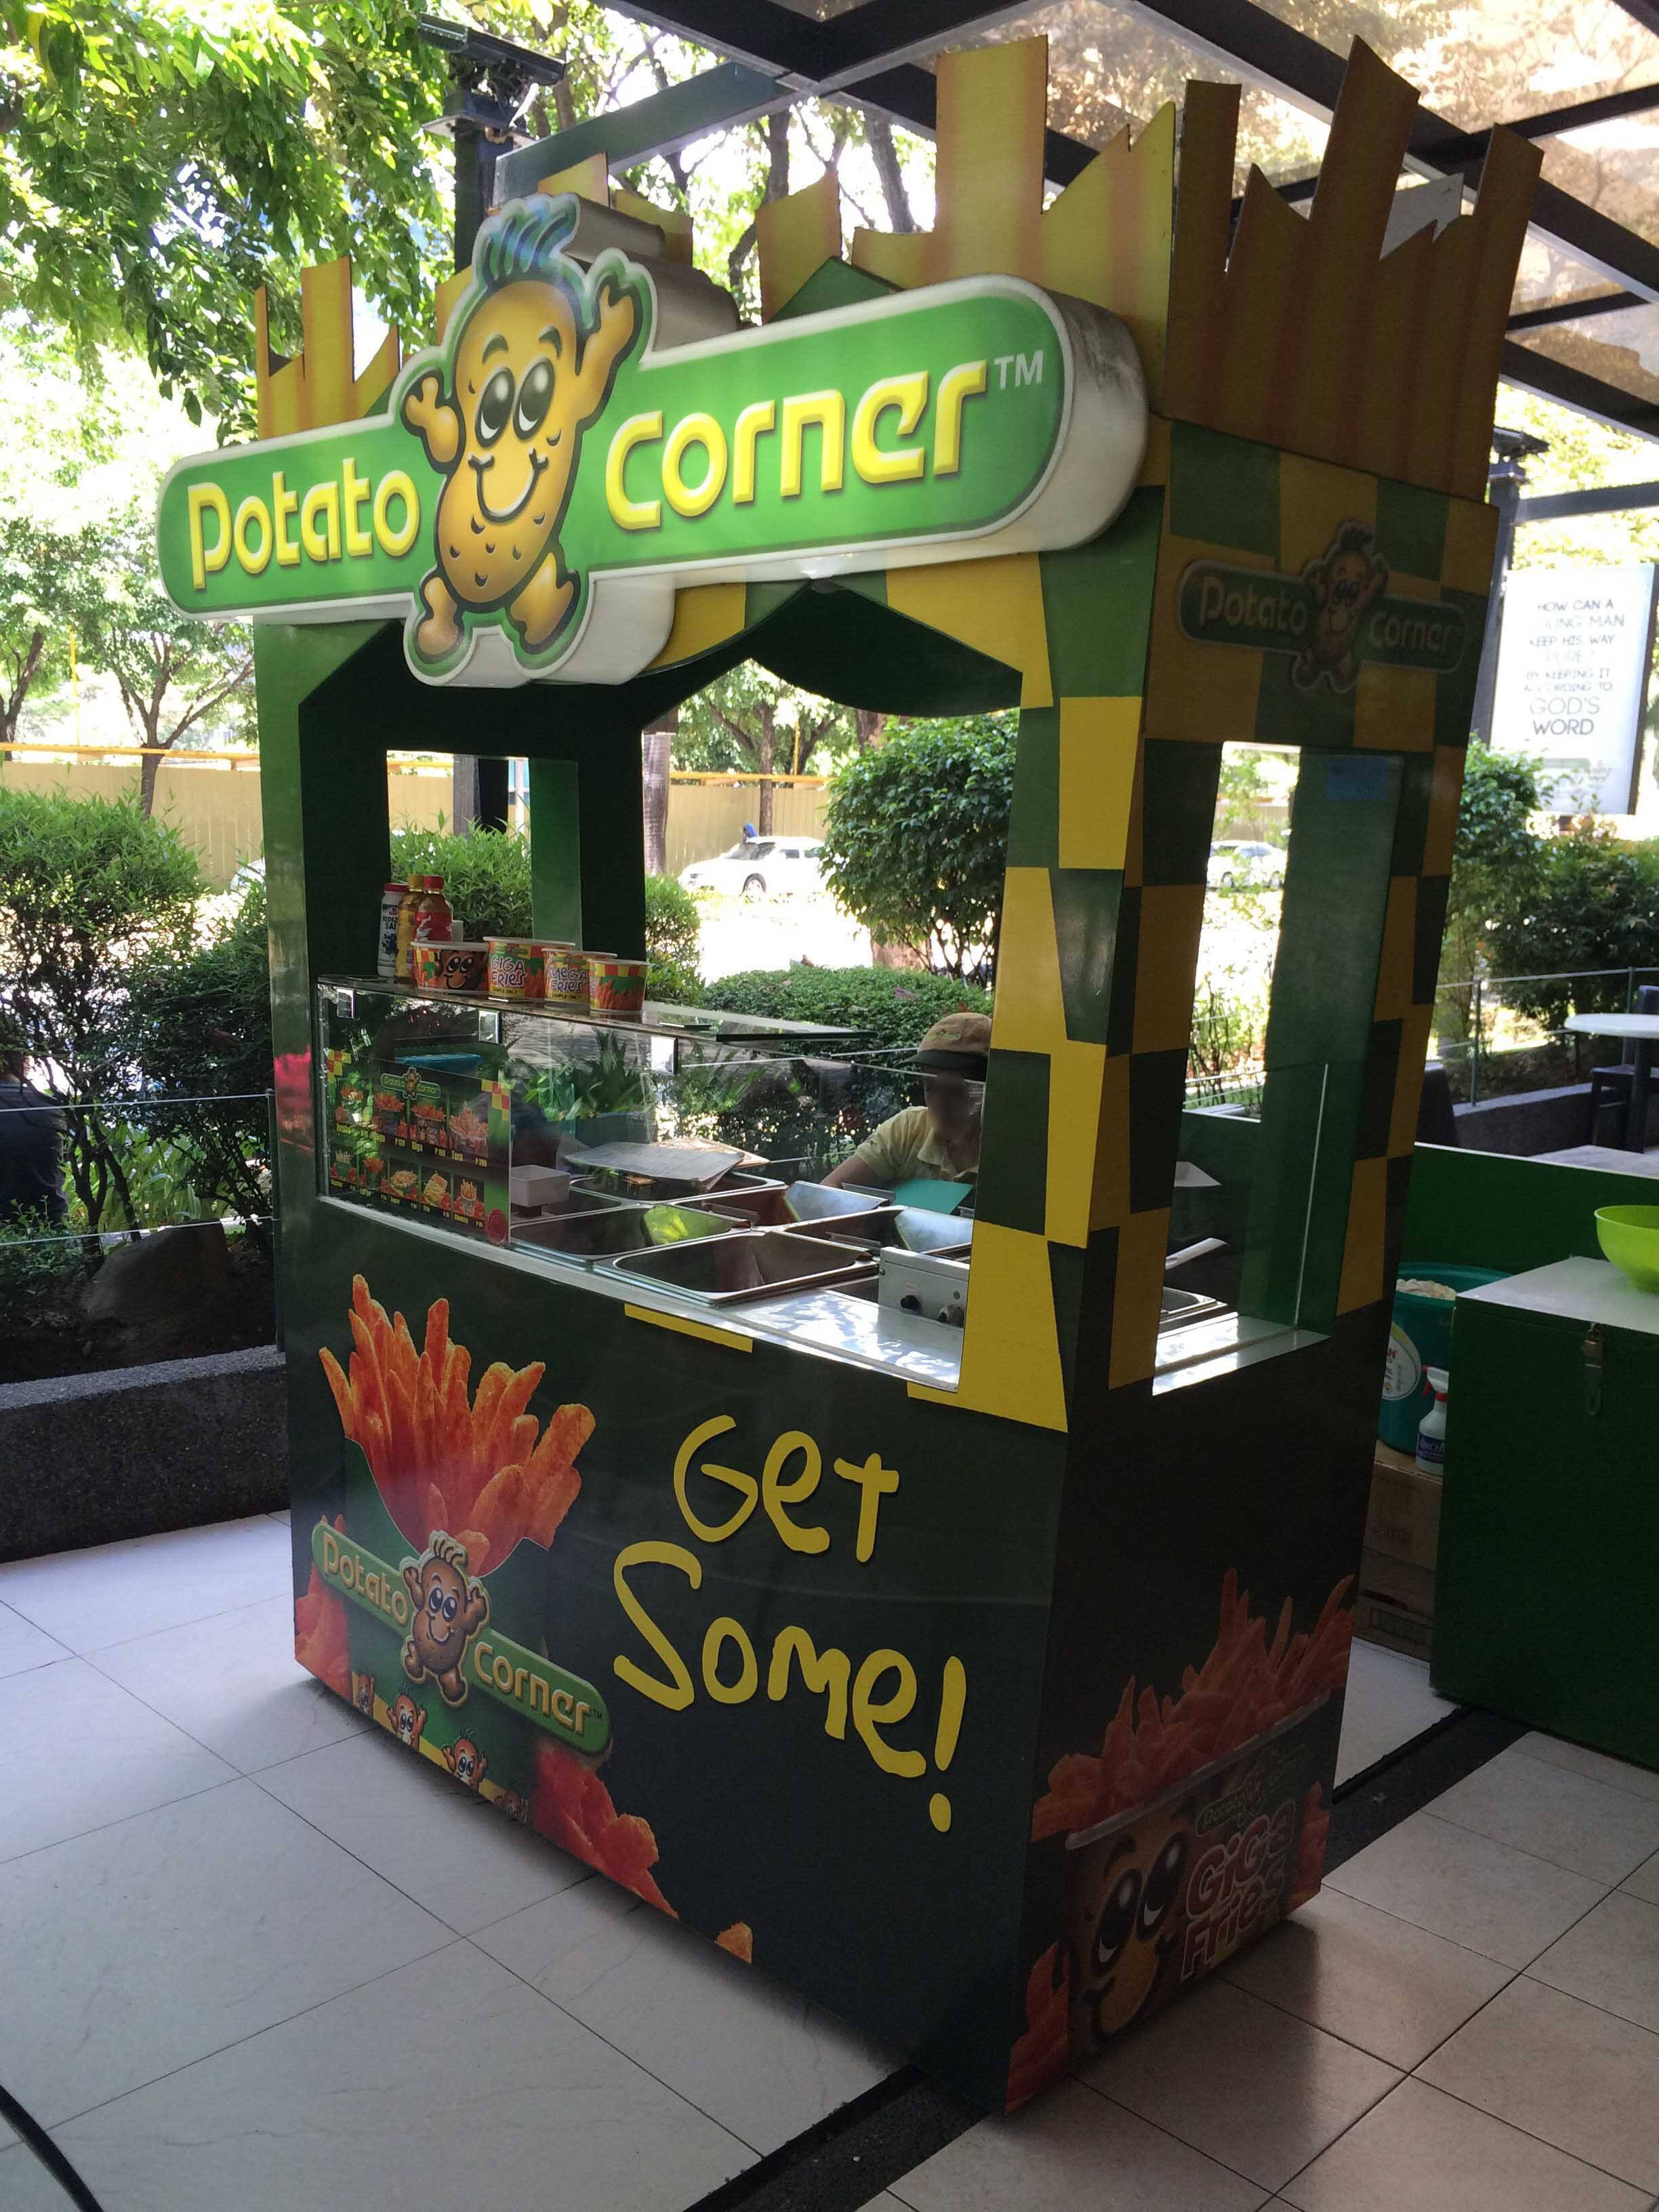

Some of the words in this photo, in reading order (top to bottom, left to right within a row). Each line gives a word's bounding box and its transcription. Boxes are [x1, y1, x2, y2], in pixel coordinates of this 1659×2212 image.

[187, 457, 419, 590] Potato
[605, 359, 987, 531] Corner
[1536, 601, 1568, 612] HOW
[1573, 599, 1601, 610] CAN
[1605, 598, 1614, 609] A
[1199, 577, 1308, 636] Potato
[1370, 611, 1454, 653] Corner
[1589, 613, 1624, 628] MAN
[1562, 634, 1583, 646] HIS
[1589, 634, 1616, 644] WAY
[1599, 668, 1610, 678] IT
[1599, 682, 1613, 691] TO
[1530, 696, 1600, 715] GOD'S
[1532, 718, 1594, 735] WORD
[491, 955, 526, 973] GIGA
[323, 1532, 408, 1626] Potato
[474, 1641, 593, 1736] Corner
